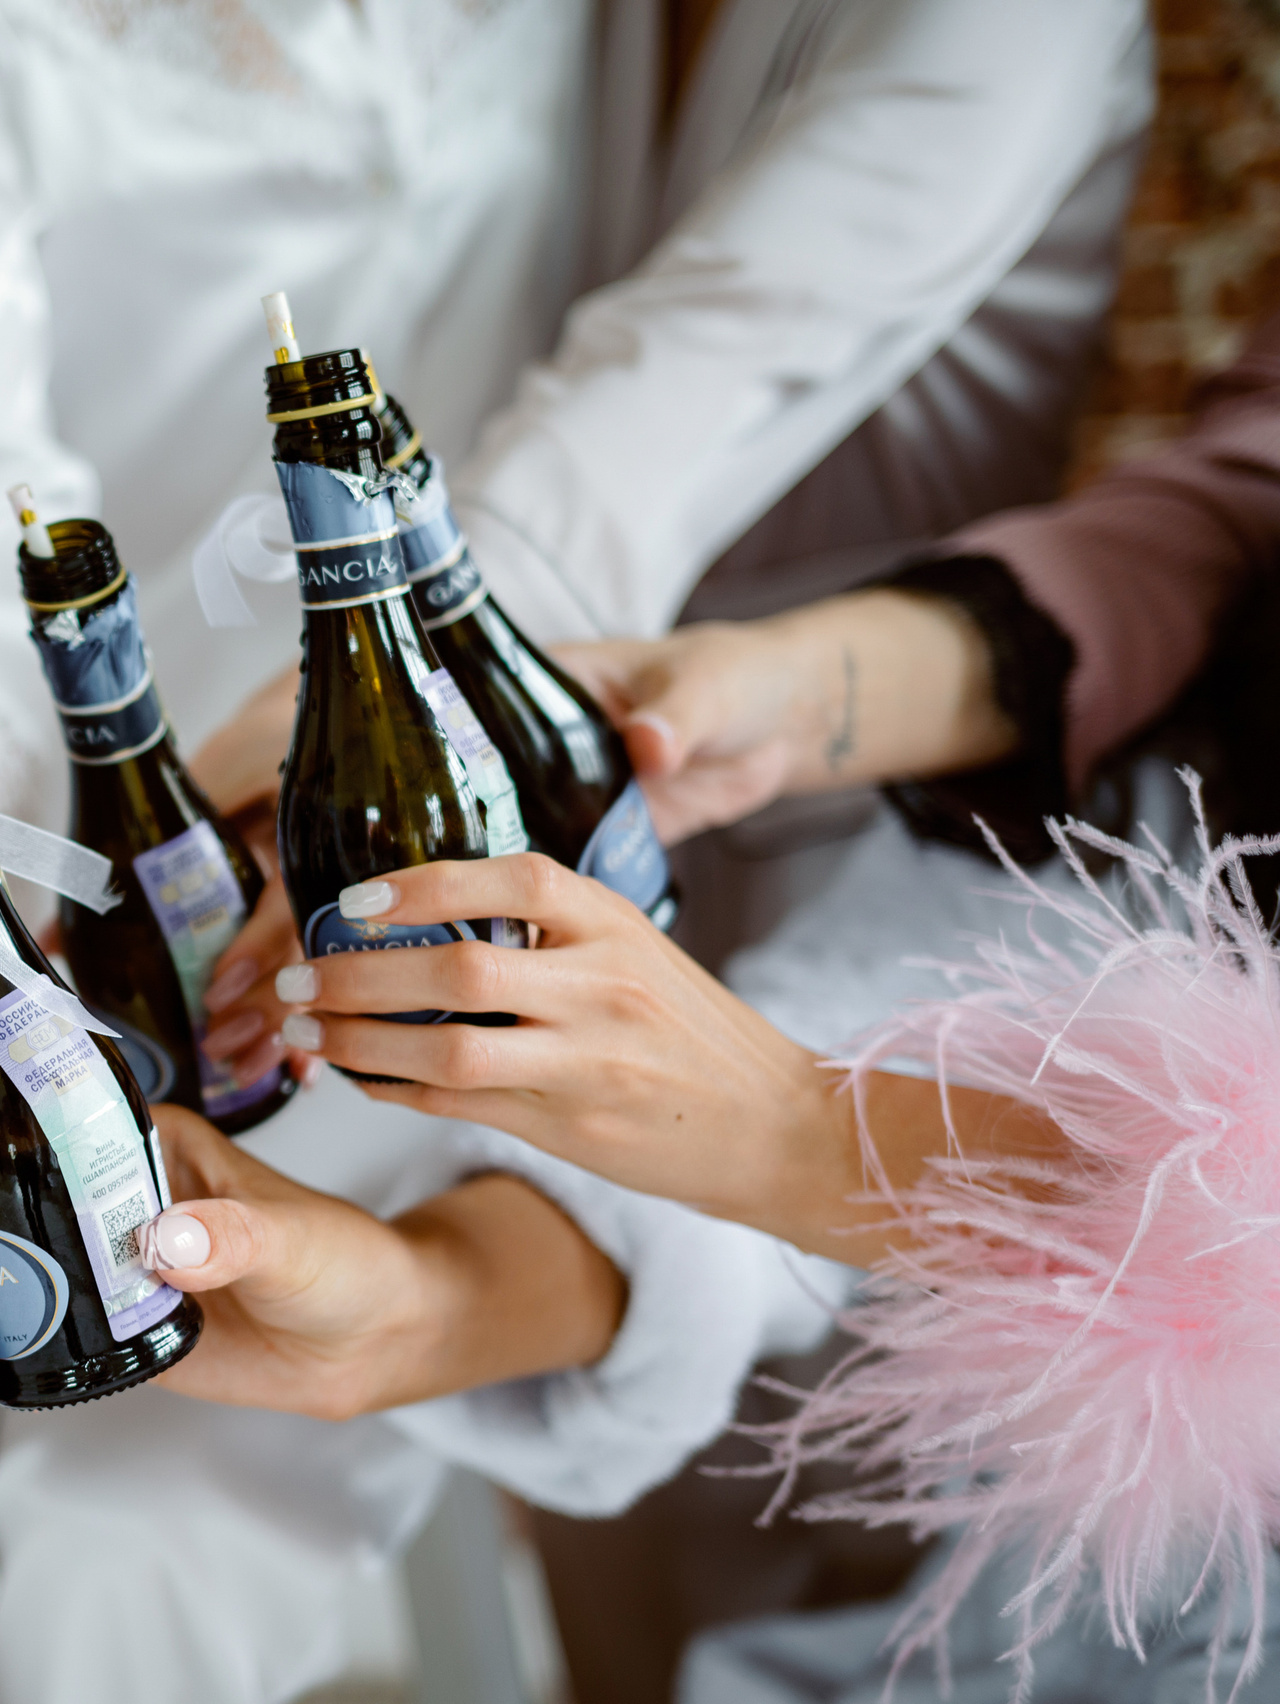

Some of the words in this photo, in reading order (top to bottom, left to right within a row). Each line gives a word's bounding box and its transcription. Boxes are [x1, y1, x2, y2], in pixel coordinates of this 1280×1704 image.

[298, 554, 395, 587] GANCIA
[68, 725, 117, 744] CIA
[24, 1038, 89, 1084] ФЕДЕРАЛЬНАЯ
[55, 1065, 88, 1090] МАРКА
[89, 1142, 126, 1170] ИГРИСТЫЕ
[95, 1139, 116, 1156] ВИНА
[82, 1148, 137, 1185] (ШАМПАНСКИЕ)
[92, 1187, 107, 1200] 400
[3, 1333, 28, 1343] ITALY
